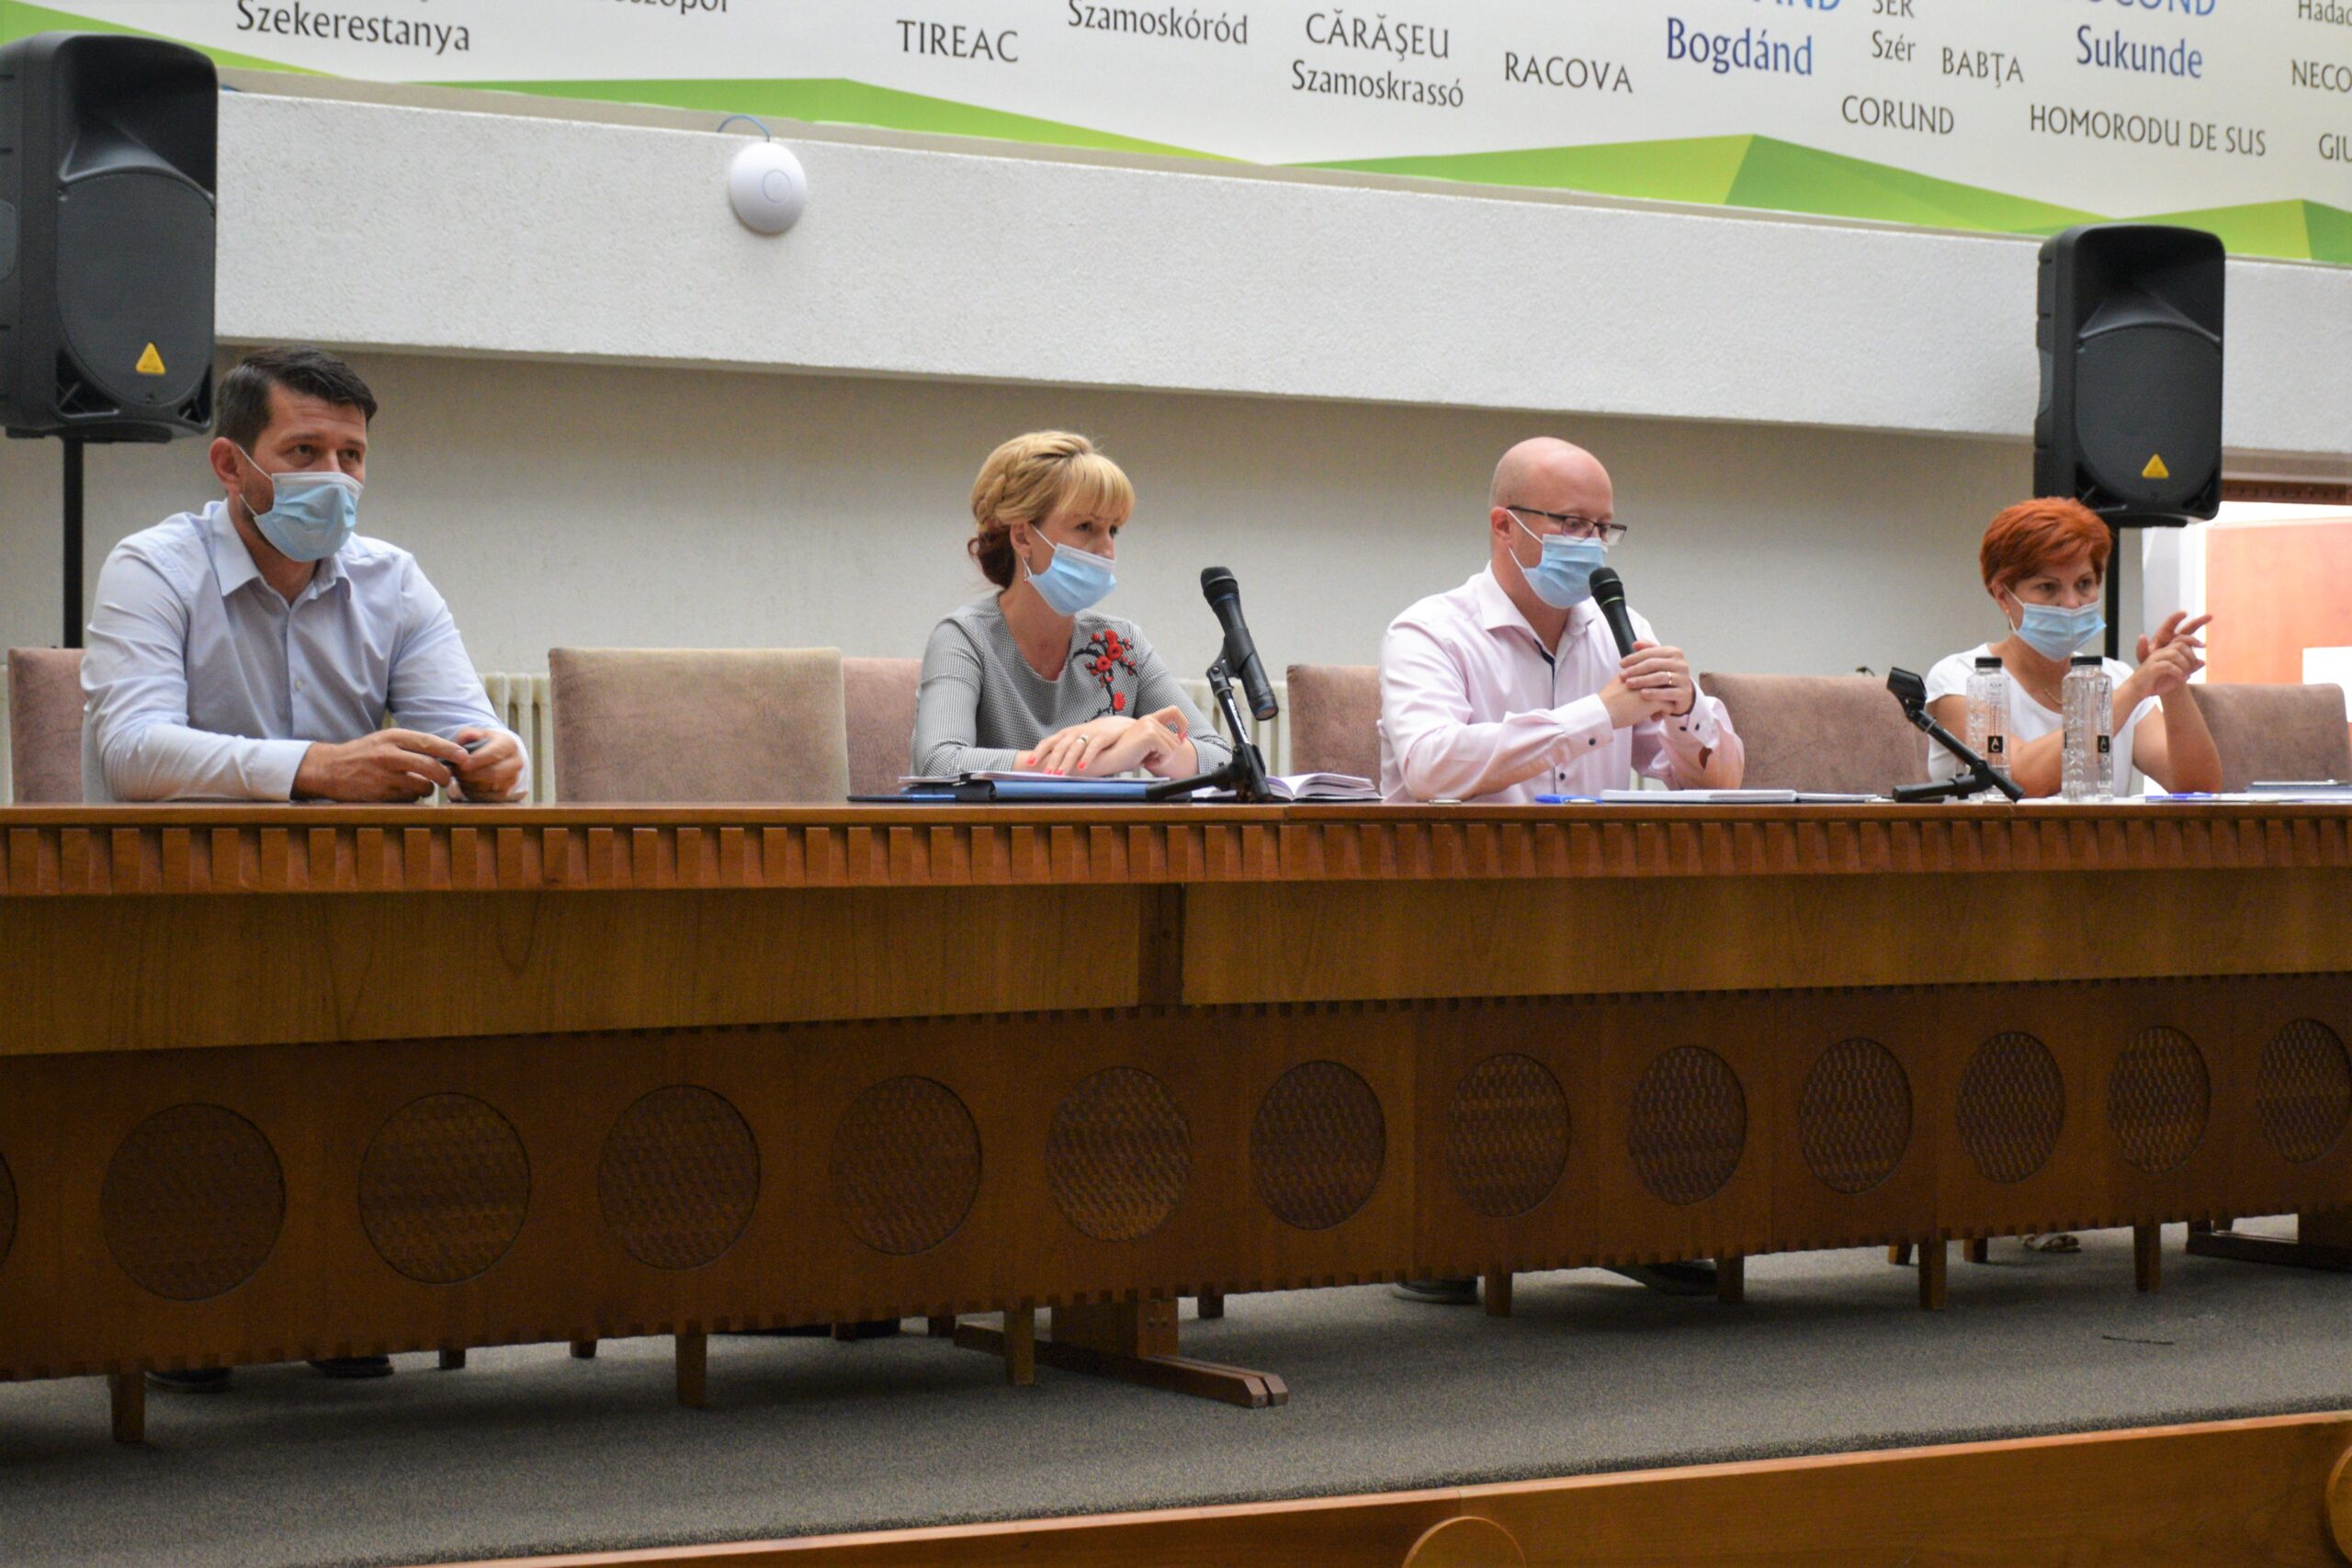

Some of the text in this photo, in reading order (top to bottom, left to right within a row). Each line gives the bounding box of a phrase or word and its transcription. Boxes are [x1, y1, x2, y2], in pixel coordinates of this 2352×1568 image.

[236, 0, 469, 55] Szekerestanya
[896, 18, 1019, 63] TIREAC
[1068, 0, 1248, 45] Szamoskóród
[1667, 17, 1813, 75] Bogdánd
[1871, 29, 1917, 62] Szér
[1505, 51, 1634, 94] RACOVA
[2076, 24, 2203, 79] Sukunde
[1292, 59, 1464, 108] Szamoskrassó
[1841, 95, 1955, 135] CORUND
[2030, 104, 2267, 157] HOMORODU DE SUS
